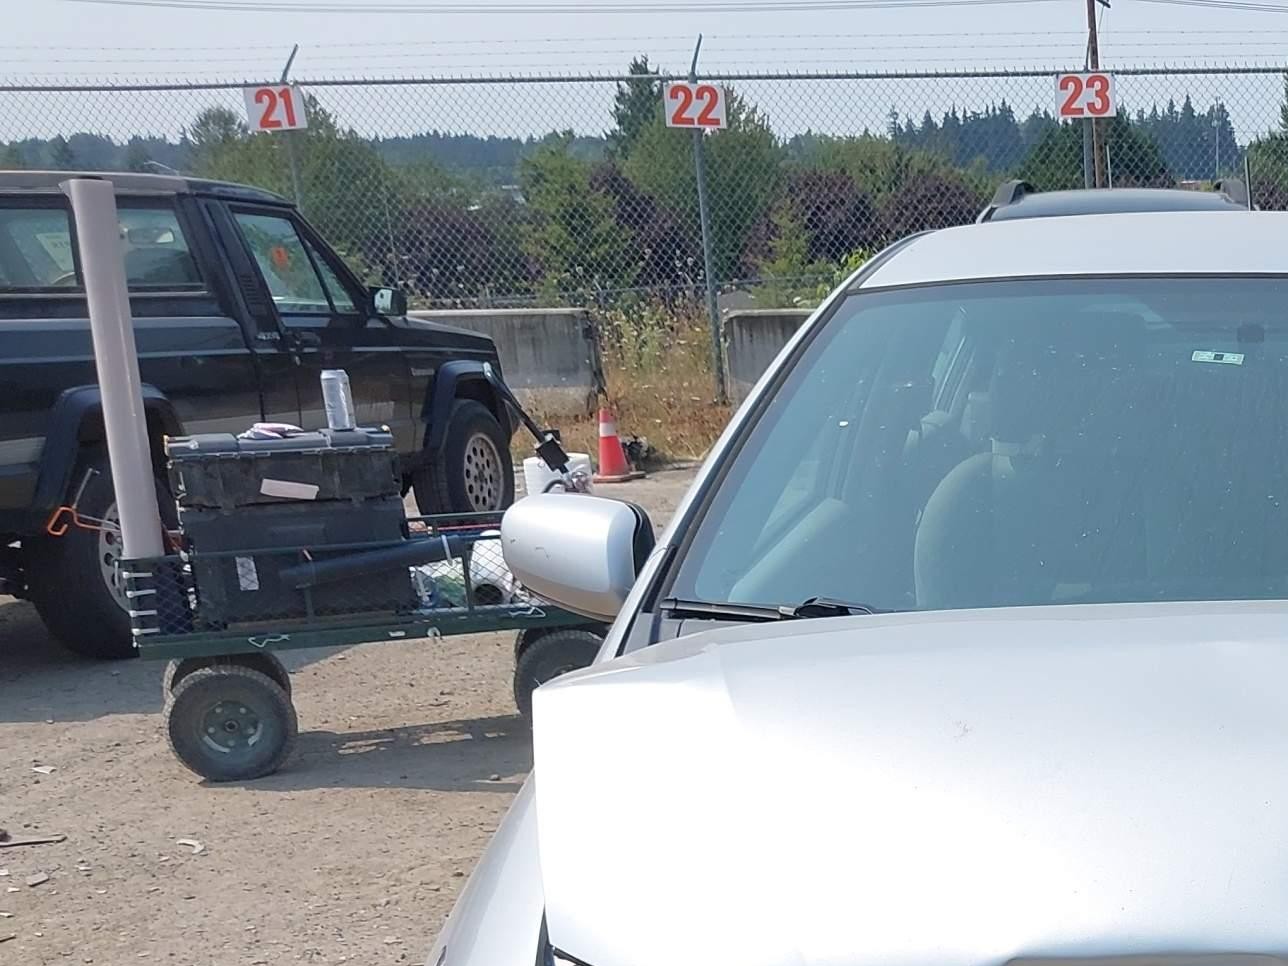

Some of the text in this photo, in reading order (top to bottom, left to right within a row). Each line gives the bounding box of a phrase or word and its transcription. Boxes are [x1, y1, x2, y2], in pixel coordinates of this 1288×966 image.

[255, 88, 296, 128] 21
[670, 85, 720, 125] 22
[1060, 75, 1110, 115] 23
